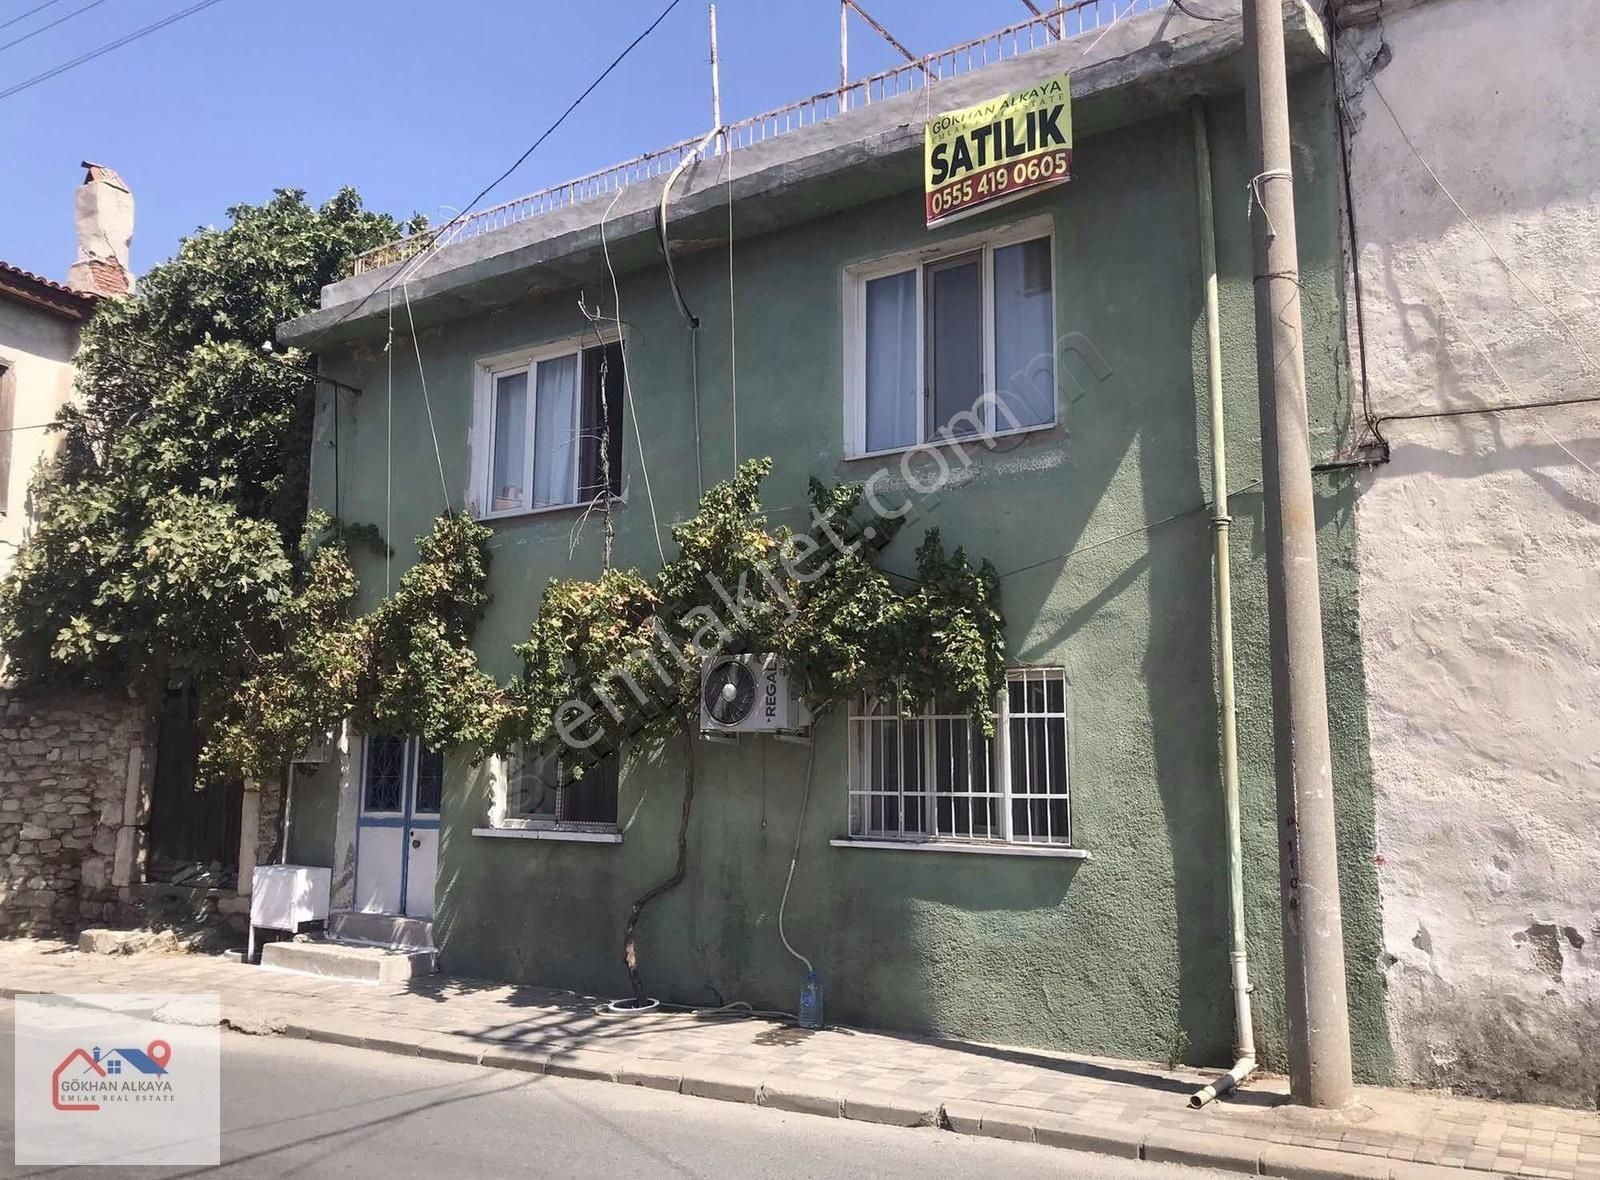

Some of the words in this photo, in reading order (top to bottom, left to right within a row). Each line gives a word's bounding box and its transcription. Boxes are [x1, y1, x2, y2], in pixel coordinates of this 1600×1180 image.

[932, 103, 995, 135] GÖKHAN
[1000, 80, 1062, 109] ALKAYA
[931, 104, 1067, 186] SATILIK
[931, 181, 973, 214] 0555
[977, 168, 1008, 195] 419
[1013, 152, 1067, 184] 0605
[765, 663, 778, 717] REGAL
